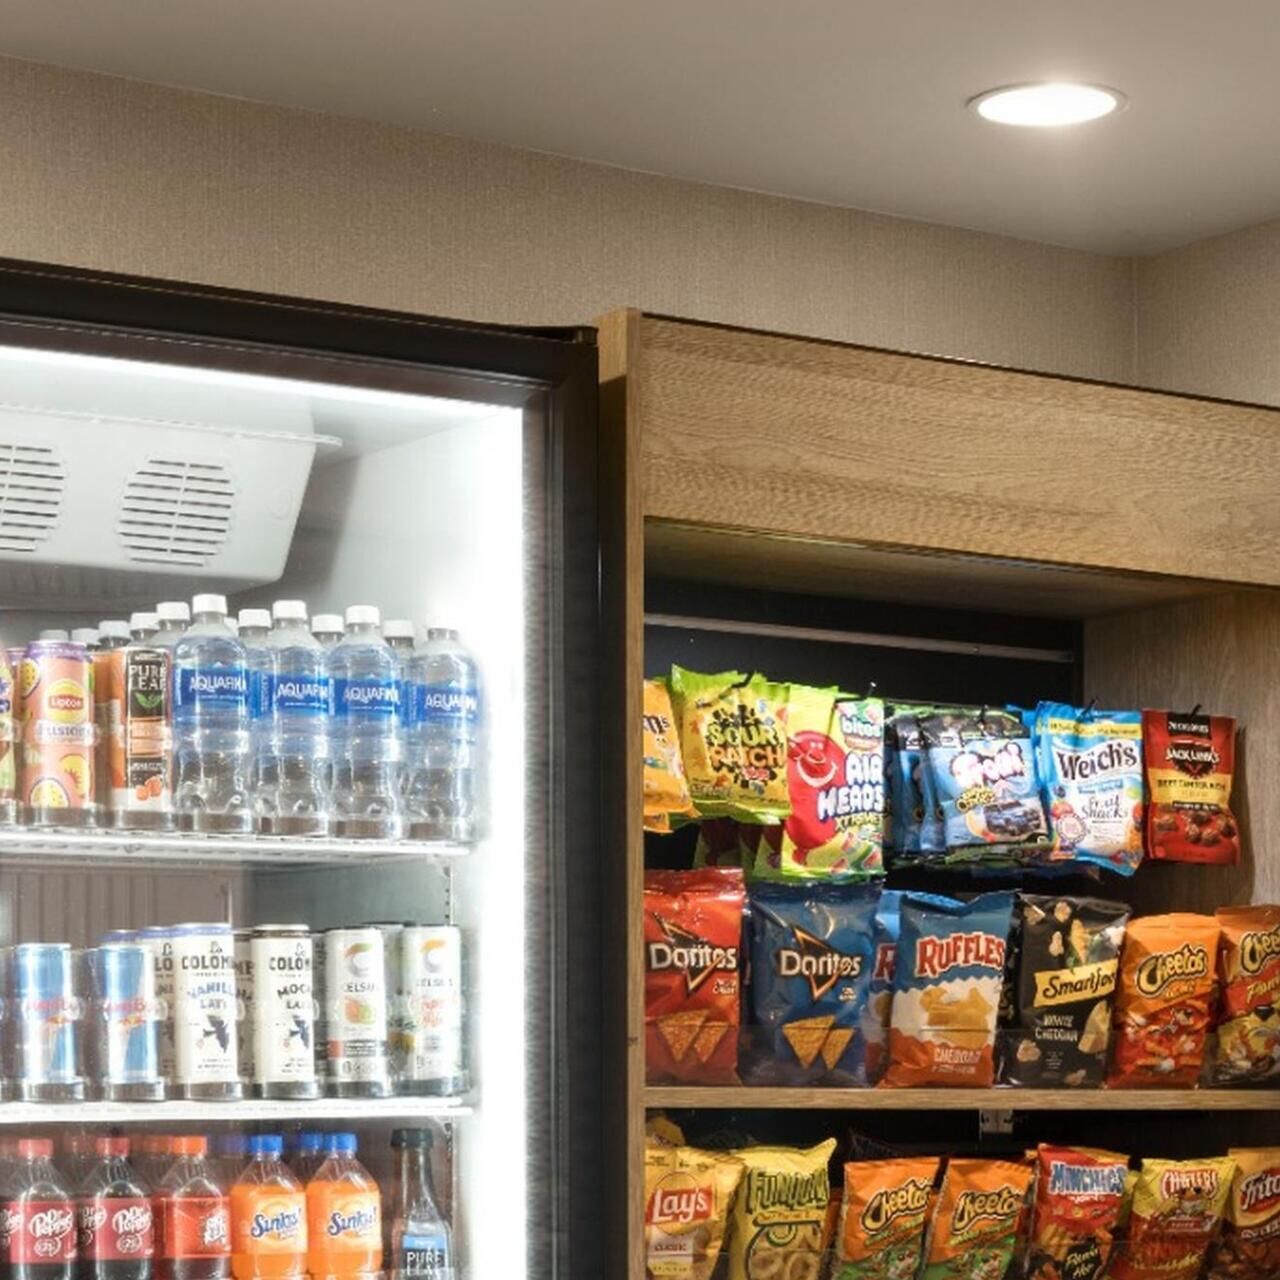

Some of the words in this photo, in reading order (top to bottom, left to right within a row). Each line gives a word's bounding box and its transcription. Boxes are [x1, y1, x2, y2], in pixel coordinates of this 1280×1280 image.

[708, 725, 780, 748] SOUR
[710, 746, 784, 767] PATCH
[846, 750, 882, 785] AIR
[1057, 742, 1138, 780] Welch's
[817, 783, 884, 820] HEADS
[182, 955, 231, 970] COLOM
[650, 943, 738, 970] Doritos
[780, 950, 862, 976] Doritos
[916, 932, 1006, 979] RUFFLES
[1136, 945, 1207, 995] Cheetos
[1041, 968, 1117, 999] Smartfoo
[652, 1188, 708, 1223] Lay's
